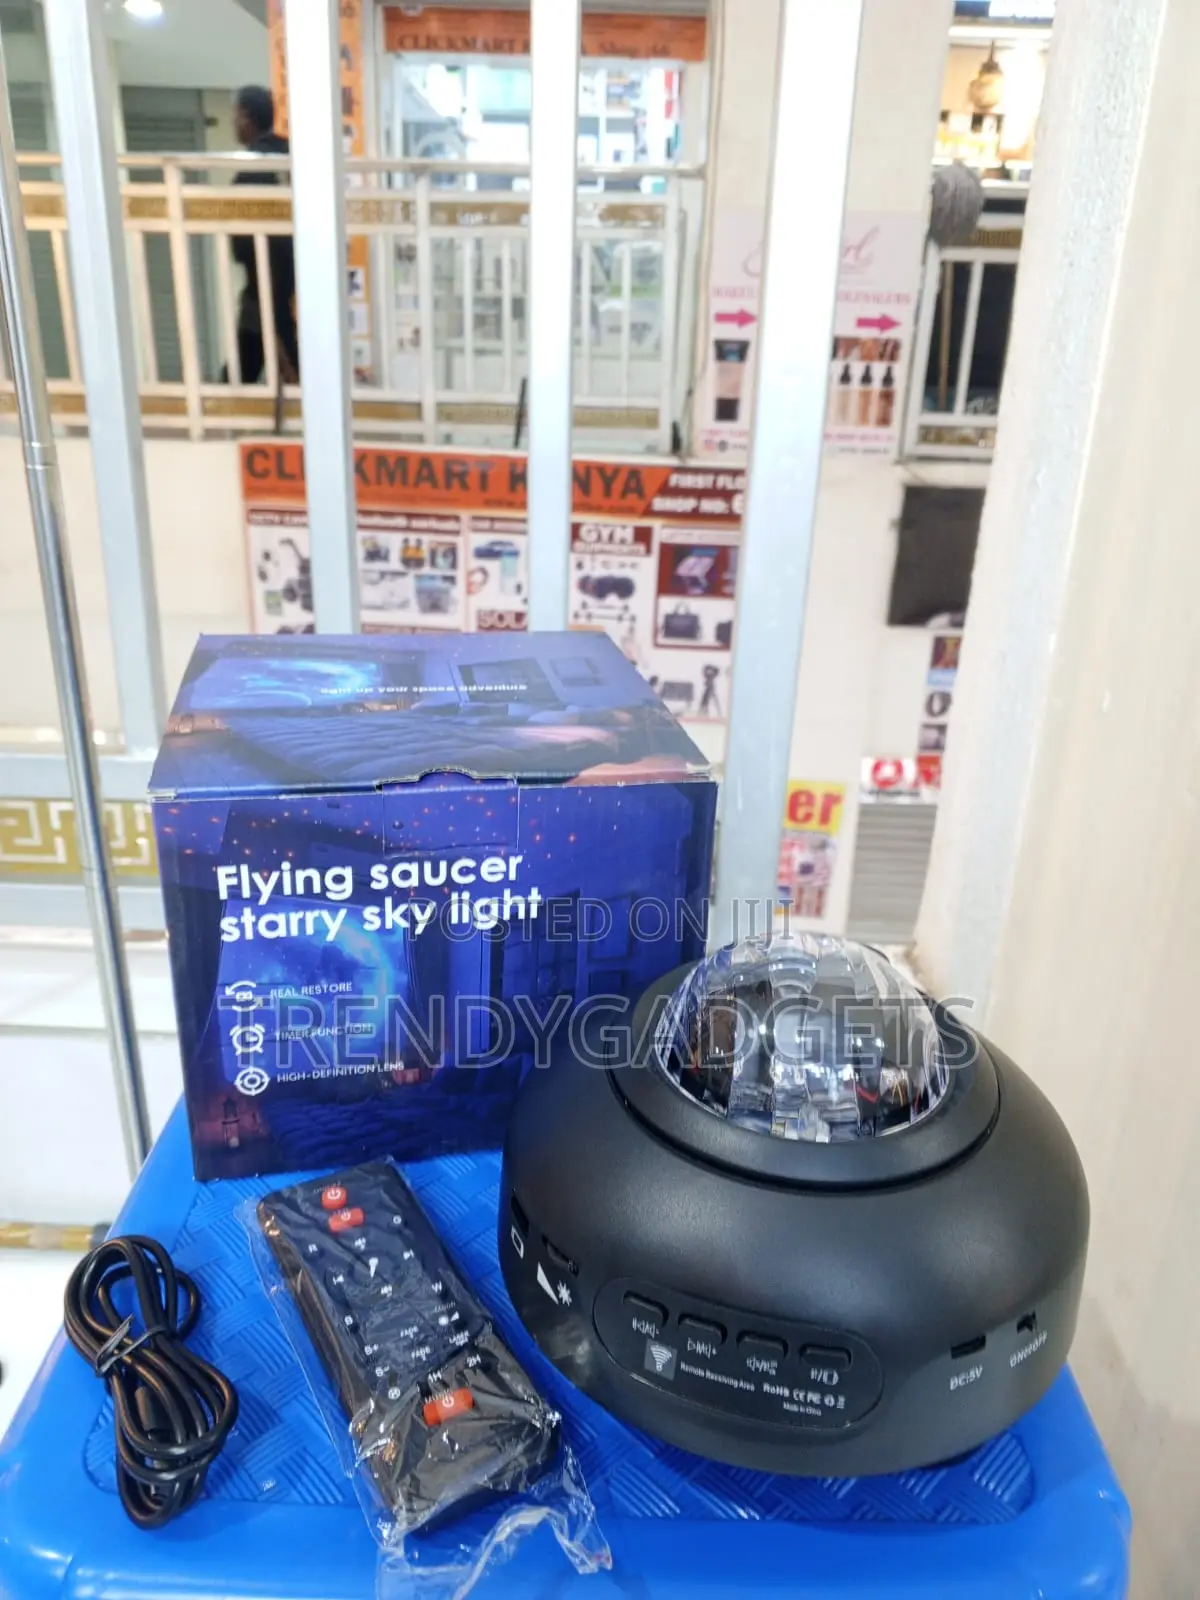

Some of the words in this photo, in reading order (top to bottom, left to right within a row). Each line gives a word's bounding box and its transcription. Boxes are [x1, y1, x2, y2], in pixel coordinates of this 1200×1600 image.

[508, 461, 646, 500] KNYA
[579, 523, 635, 544] GYM
[217, 861, 353, 905] Flying
[370, 854, 523, 890] saucer
[220, 907, 348, 942] starry
[362, 896, 436, 935] sky
[450, 886, 541, 931] light
[270, 987, 297, 999] REAL
[301, 981, 353, 996] RESTORE
[276, 1029, 312, 1041] TIMER
[312, 1023, 373, 1038] FUNCTION
[277, 1065, 375, 1083] HIGH-DEFINITION
[377, 1060, 405, 1073] LENS
